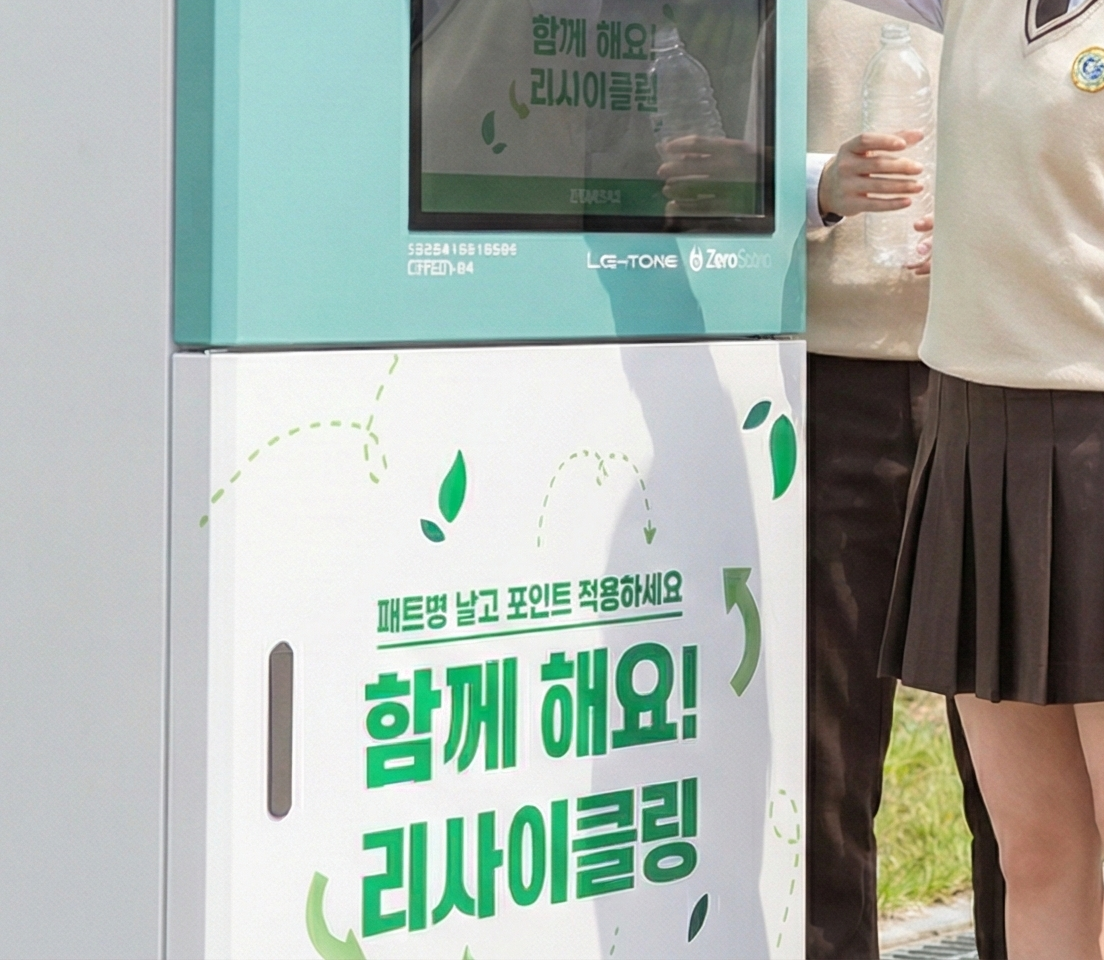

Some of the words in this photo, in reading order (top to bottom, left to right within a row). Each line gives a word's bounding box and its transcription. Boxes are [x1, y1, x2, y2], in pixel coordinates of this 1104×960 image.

[532, 14, 586, 57] 함께
[456, 588, 500, 627] 날고
[507, 582, 572, 620] 포인트
[579, 570, 683, 612] 적용하세요
[364, 656, 518, 789] 함께
[541, 642, 698, 758] 해요!
[361, 776, 698, 938] 리사이클링
